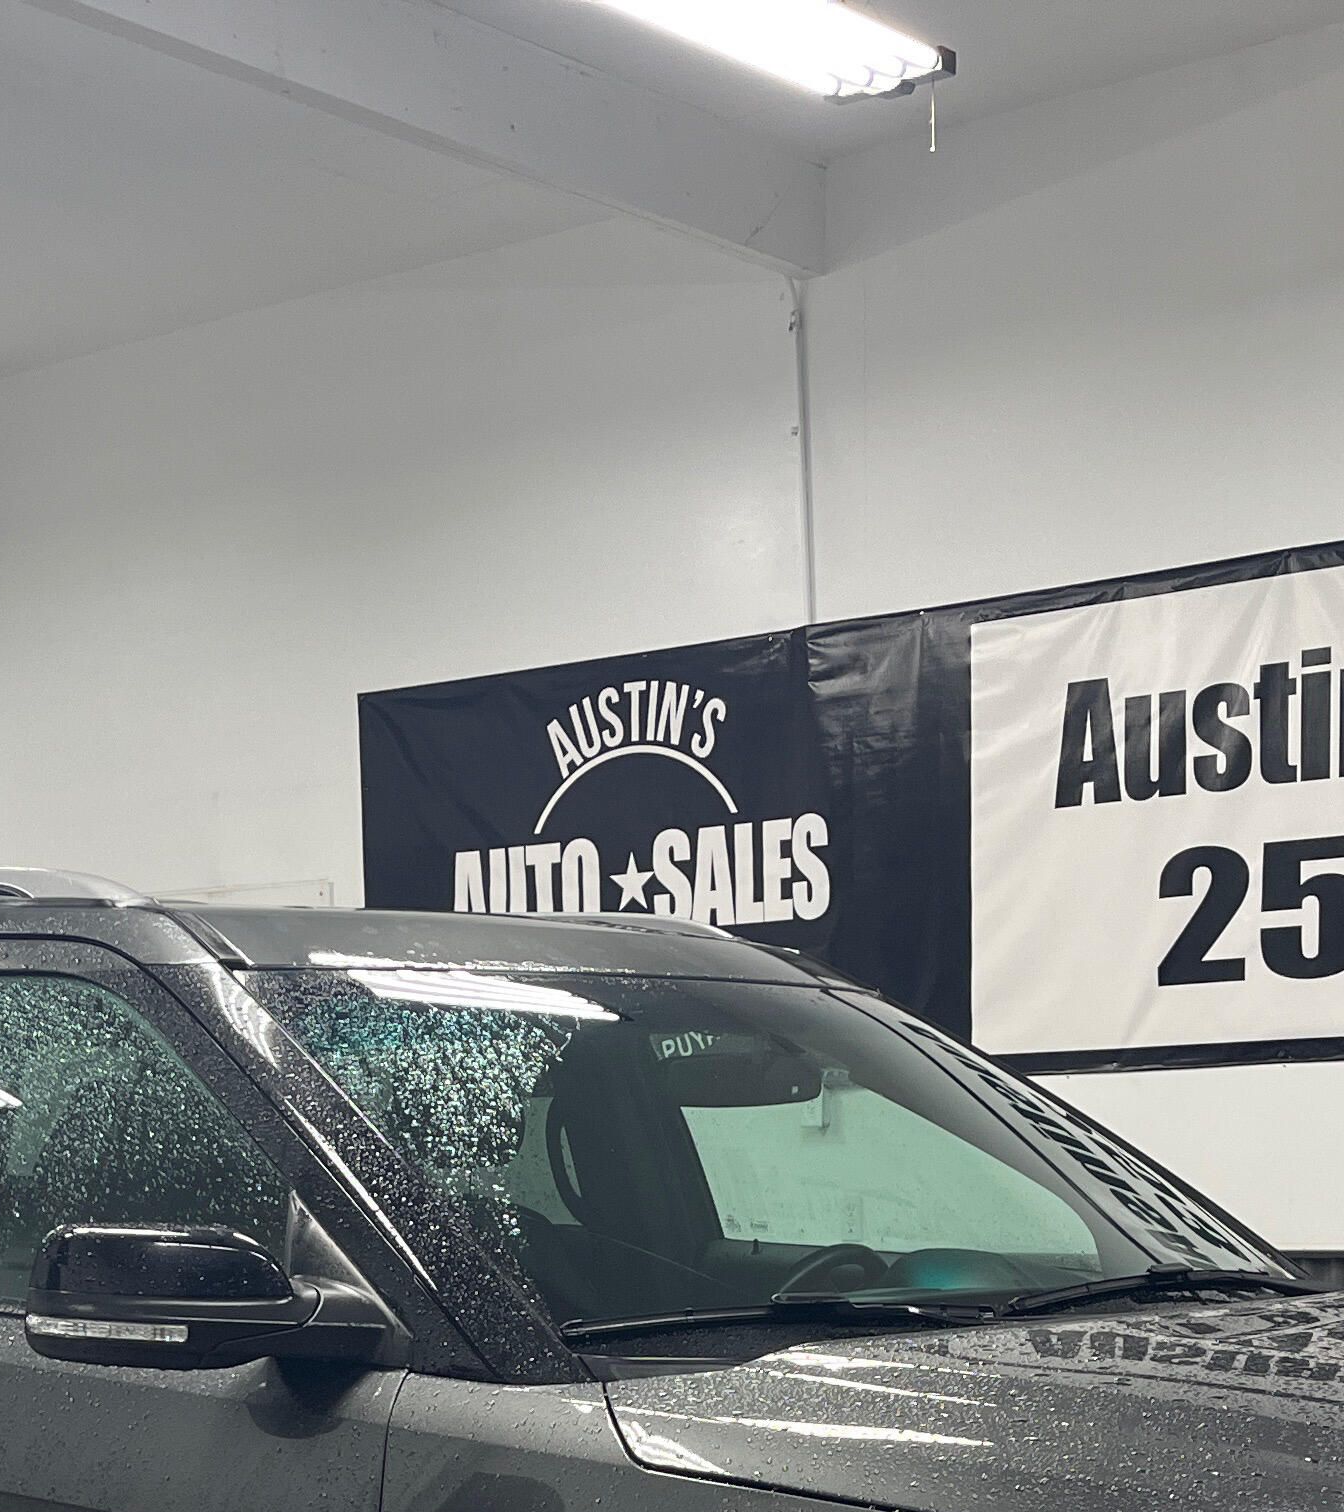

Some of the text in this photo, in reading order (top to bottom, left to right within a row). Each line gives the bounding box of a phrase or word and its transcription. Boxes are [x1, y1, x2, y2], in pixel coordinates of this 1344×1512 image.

[546, 680, 727, 780] AUSTIN'S
[453, 813, 830, 927] AUTO SALES
